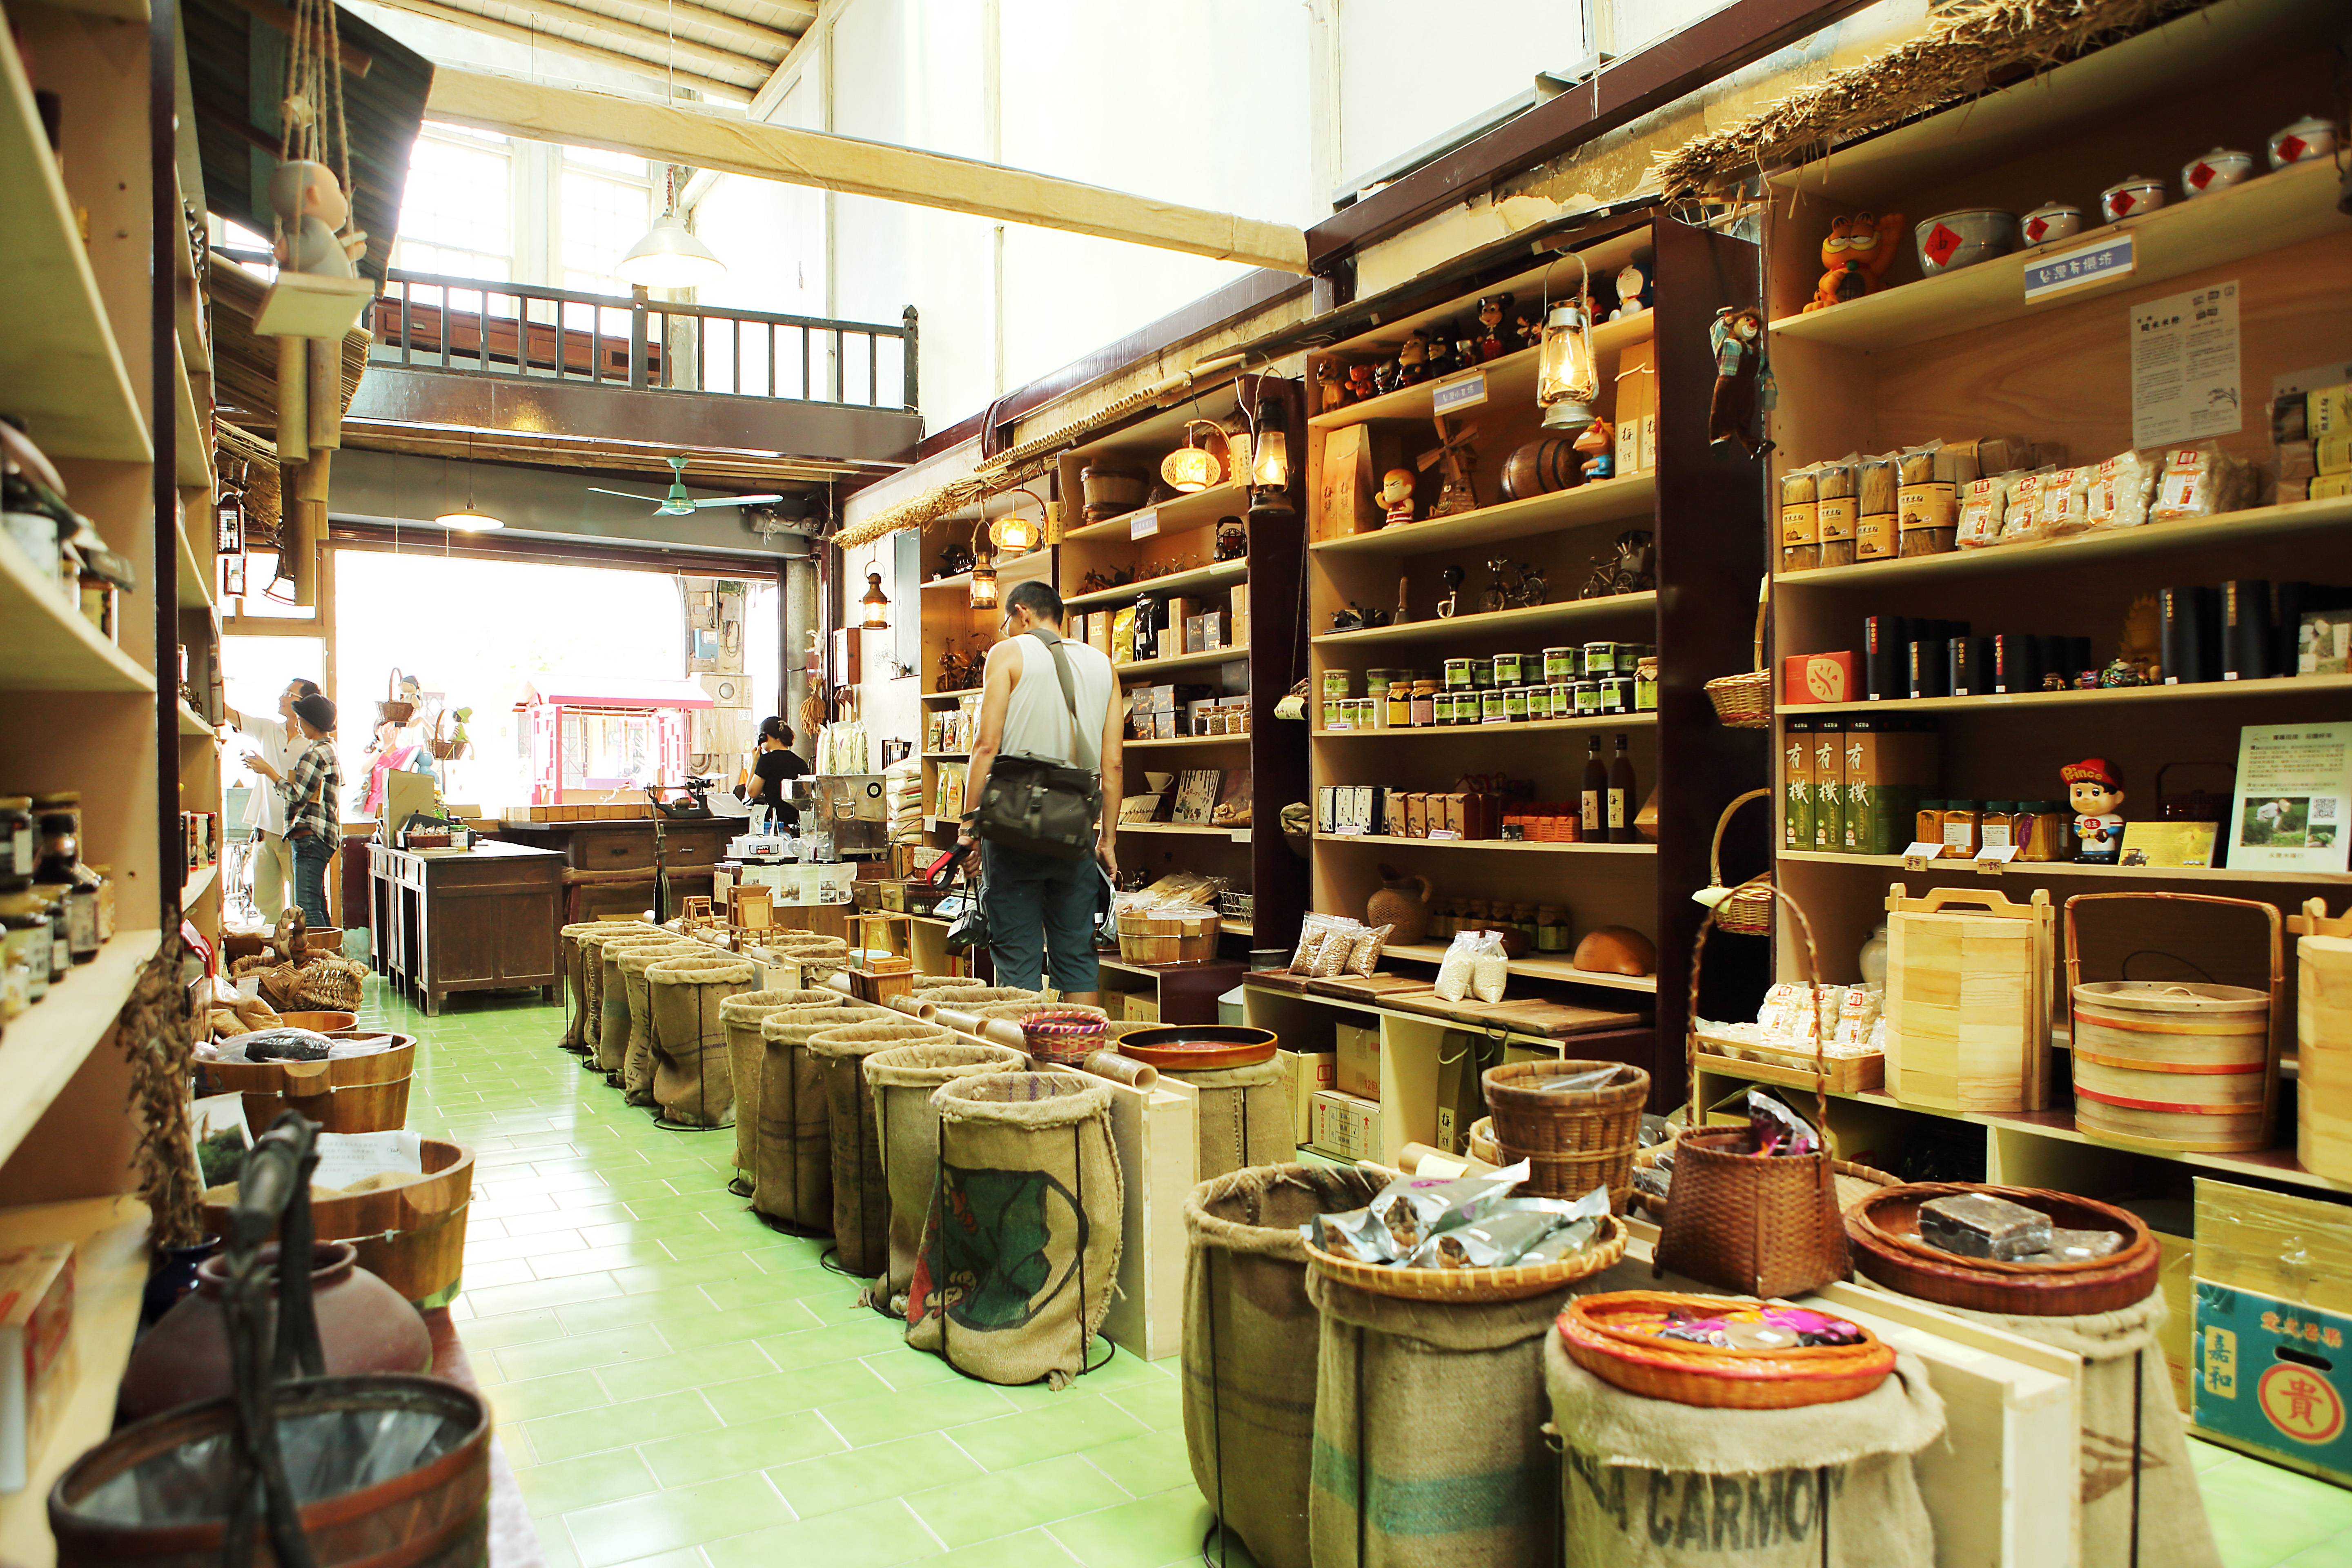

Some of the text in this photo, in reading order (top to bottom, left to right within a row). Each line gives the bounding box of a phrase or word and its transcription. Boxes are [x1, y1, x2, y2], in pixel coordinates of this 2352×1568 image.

[2039, 252, 2113, 283] 台灣有機坊
[1091, 625, 1102, 634] TCC
[1786, 742, 1809, 804] 有機
[1815, 742, 1840, 805] 有機
[1846, 742, 1870, 806] 有機
[2063, 766, 2103, 781] Prince
[2084, 819, 2098, 829] 味王
[1364, 1079, 1377, 1093] 12包
[2207, 1333, 2232, 1390] 嘉和
[2279, 1377, 2323, 1428] 貴
